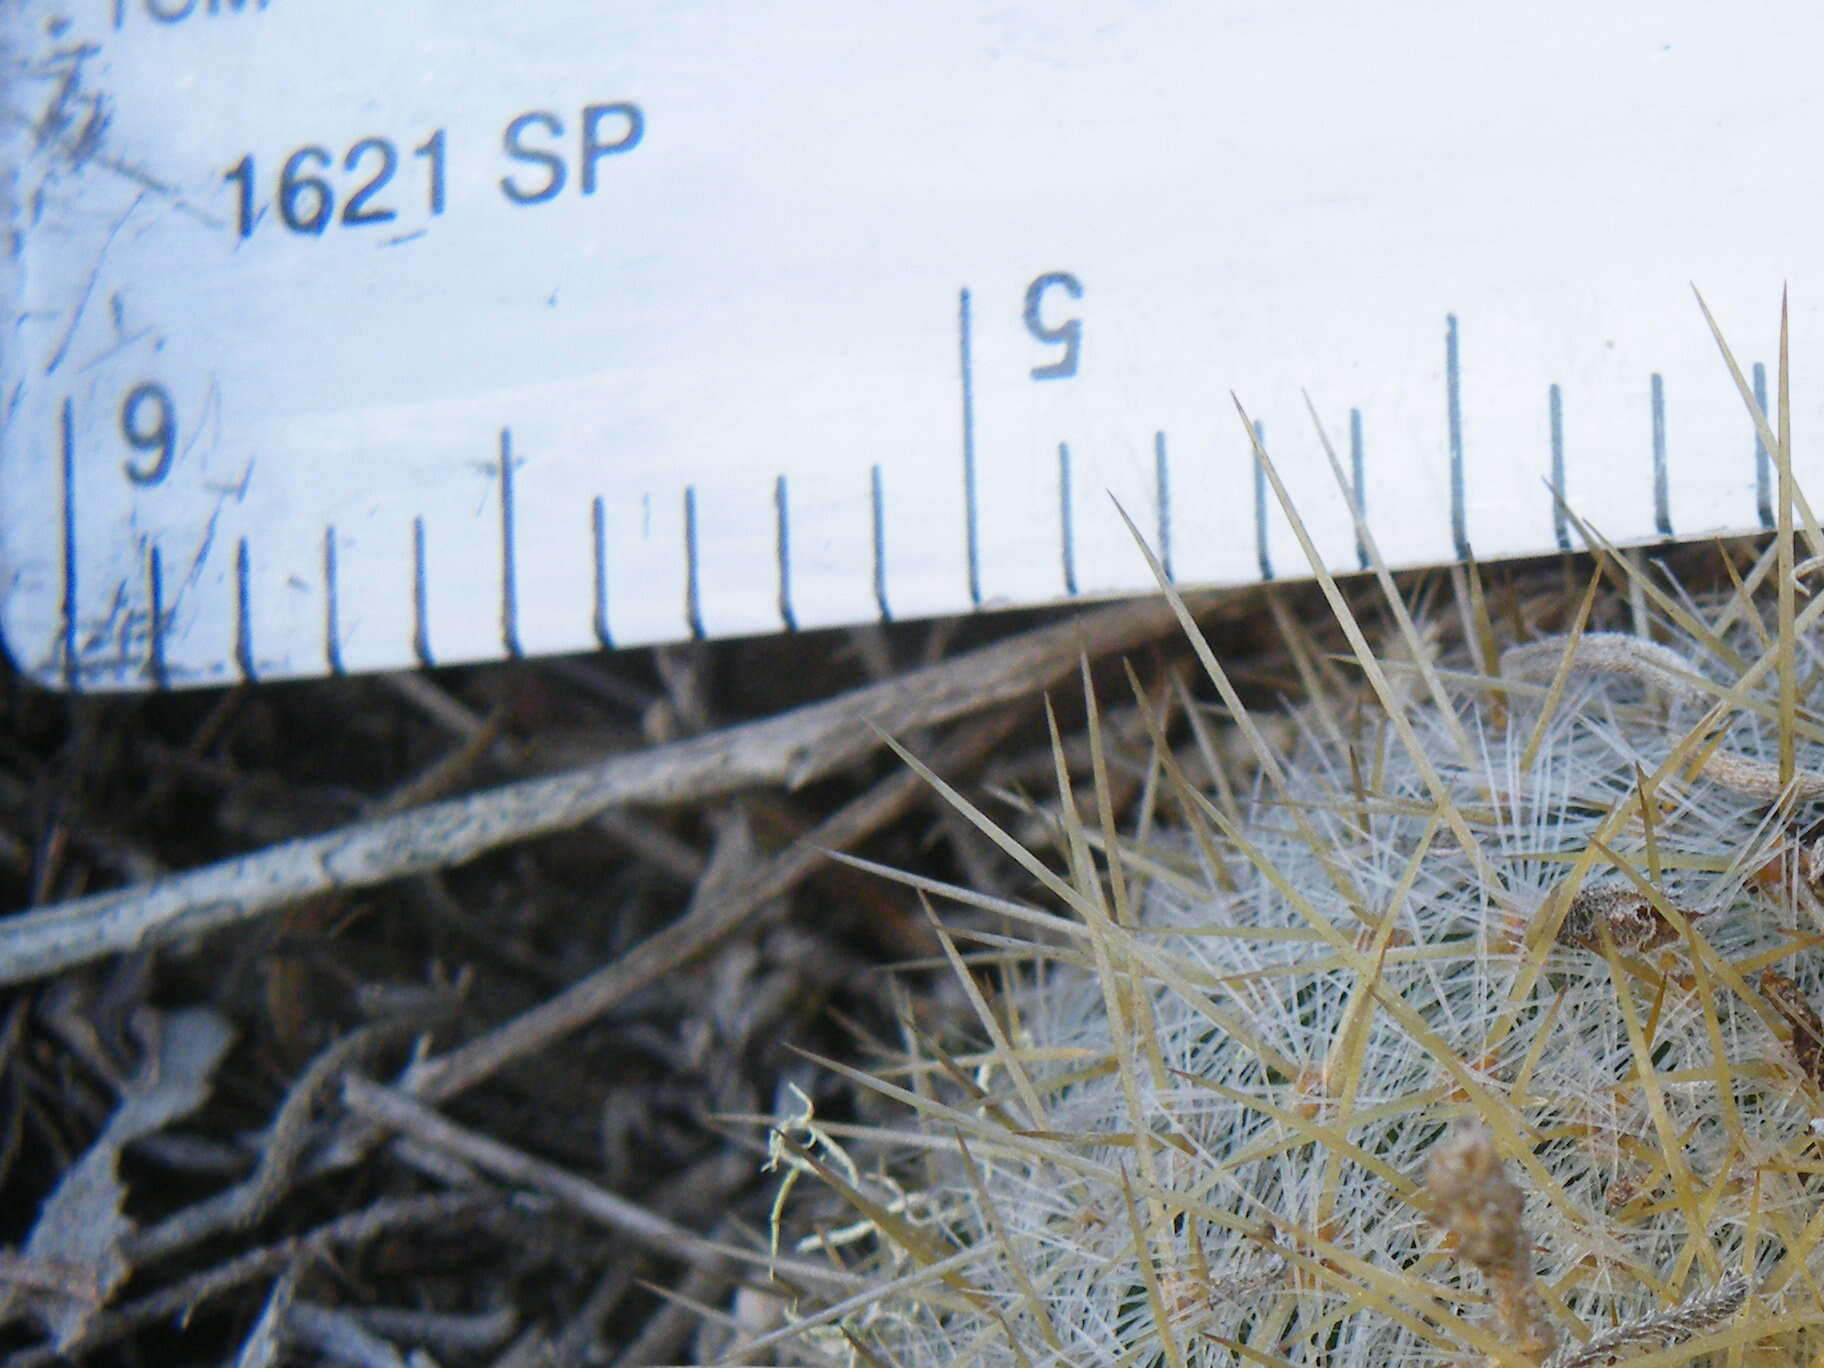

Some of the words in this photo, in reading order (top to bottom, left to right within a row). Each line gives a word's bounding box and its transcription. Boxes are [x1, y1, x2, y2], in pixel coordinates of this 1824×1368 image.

[222, 128, 447, 239] 1621
[500, 102, 646, 207] SP
[1022, 271, 1085, 381] 5
